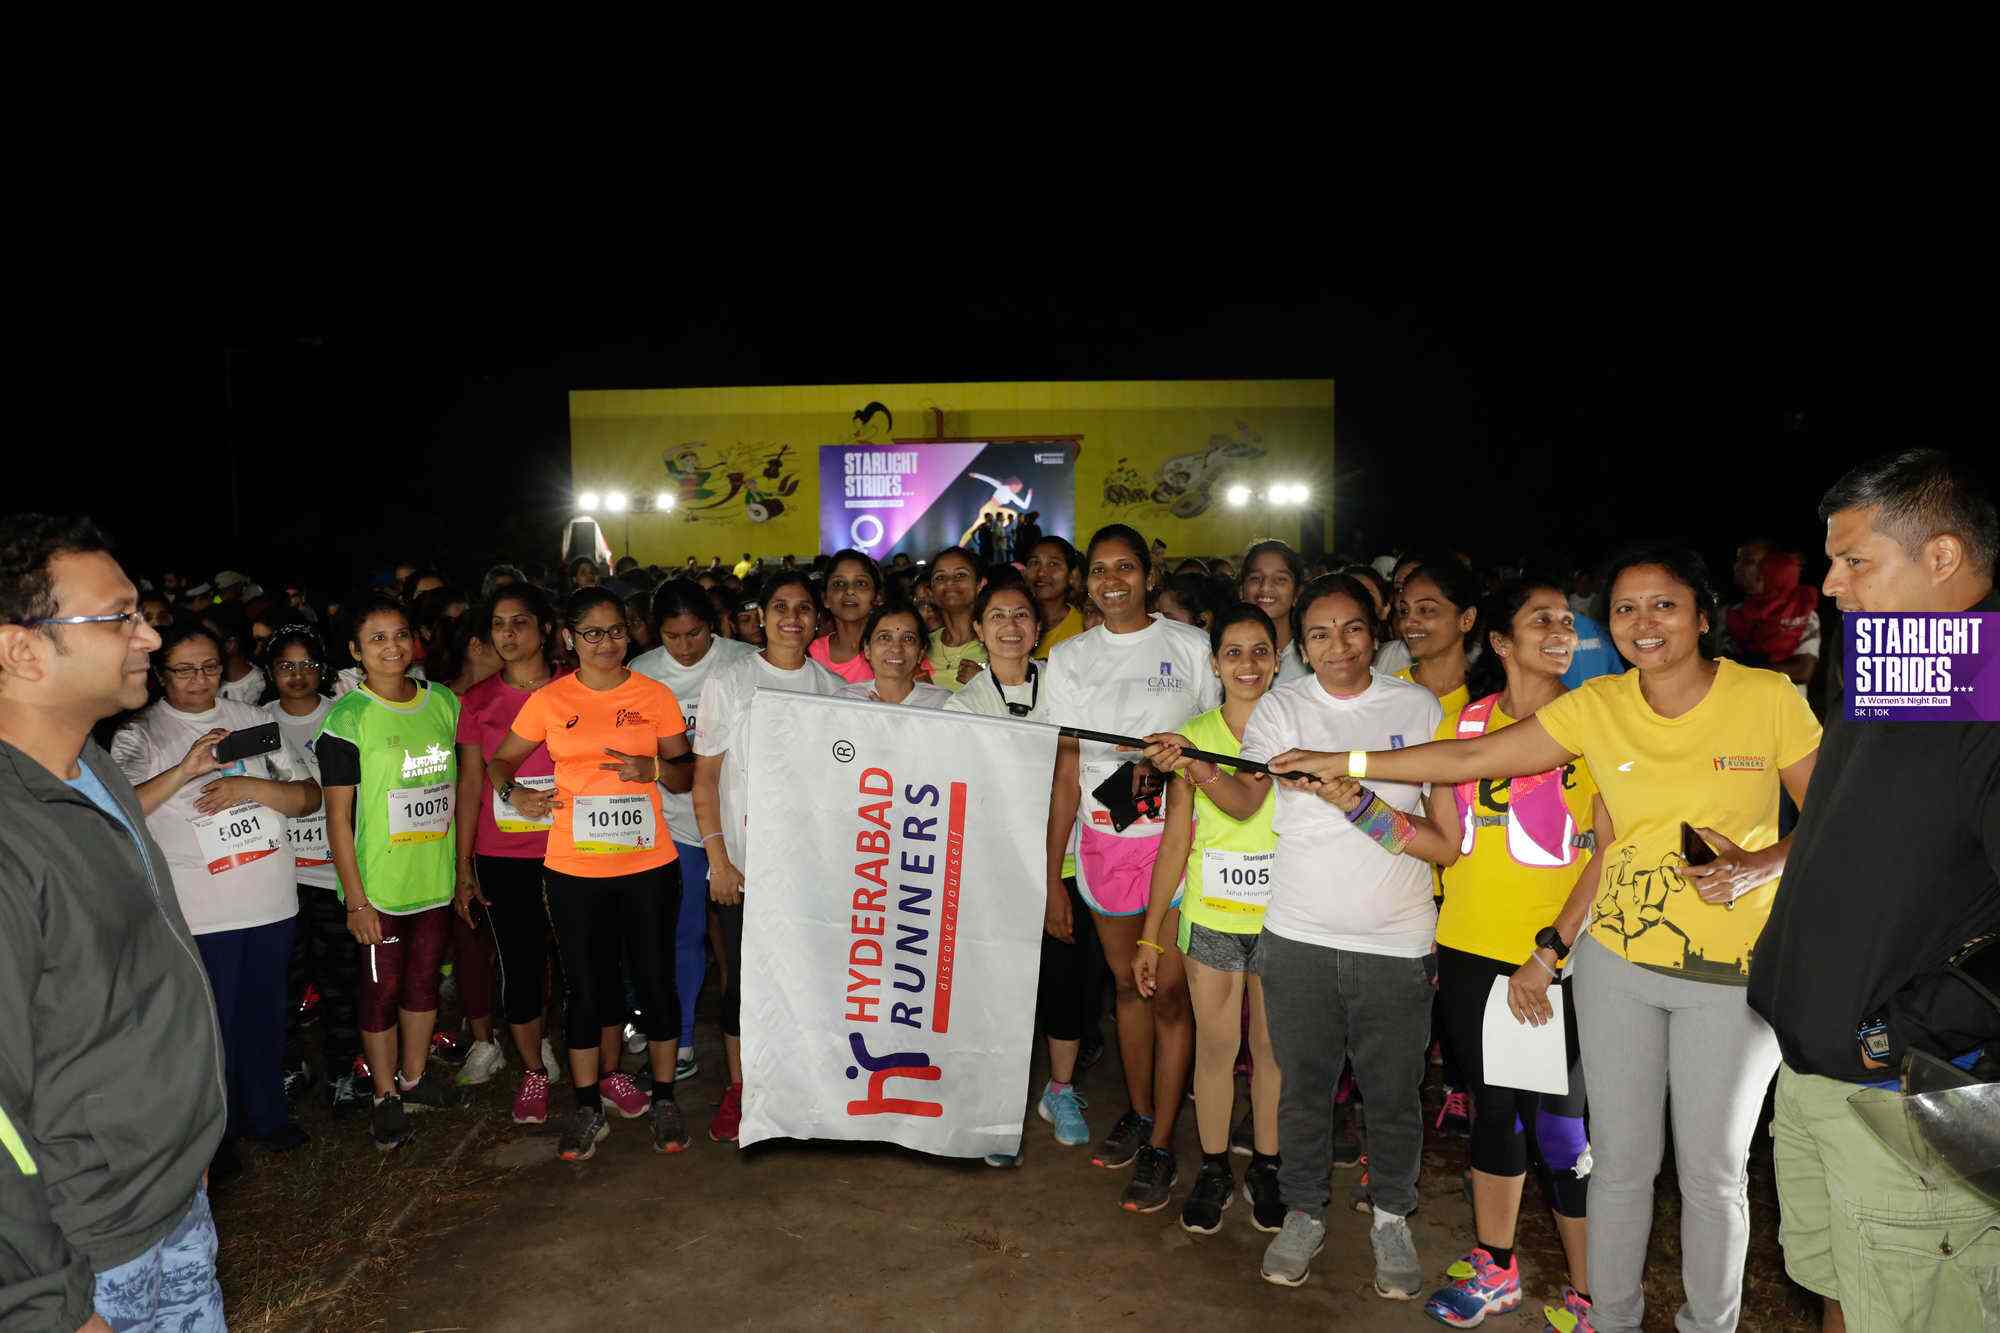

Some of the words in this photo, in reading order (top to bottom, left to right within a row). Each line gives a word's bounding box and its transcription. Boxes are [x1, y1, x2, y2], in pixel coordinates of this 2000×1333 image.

[844, 452, 918, 474] STARLIGHT
[1147, 677, 1183, 689] CARE
[404, 796, 449, 818] 10078
[588, 809, 642, 827] 10106
[218, 815, 261, 842] 5081
[1243, 853, 1269, 861] Starlight
[1218, 867, 1270, 886] 1005
[845, 767, 894, 1023] HYDERABAD
[890, 783, 940, 1030] RUNNERS
